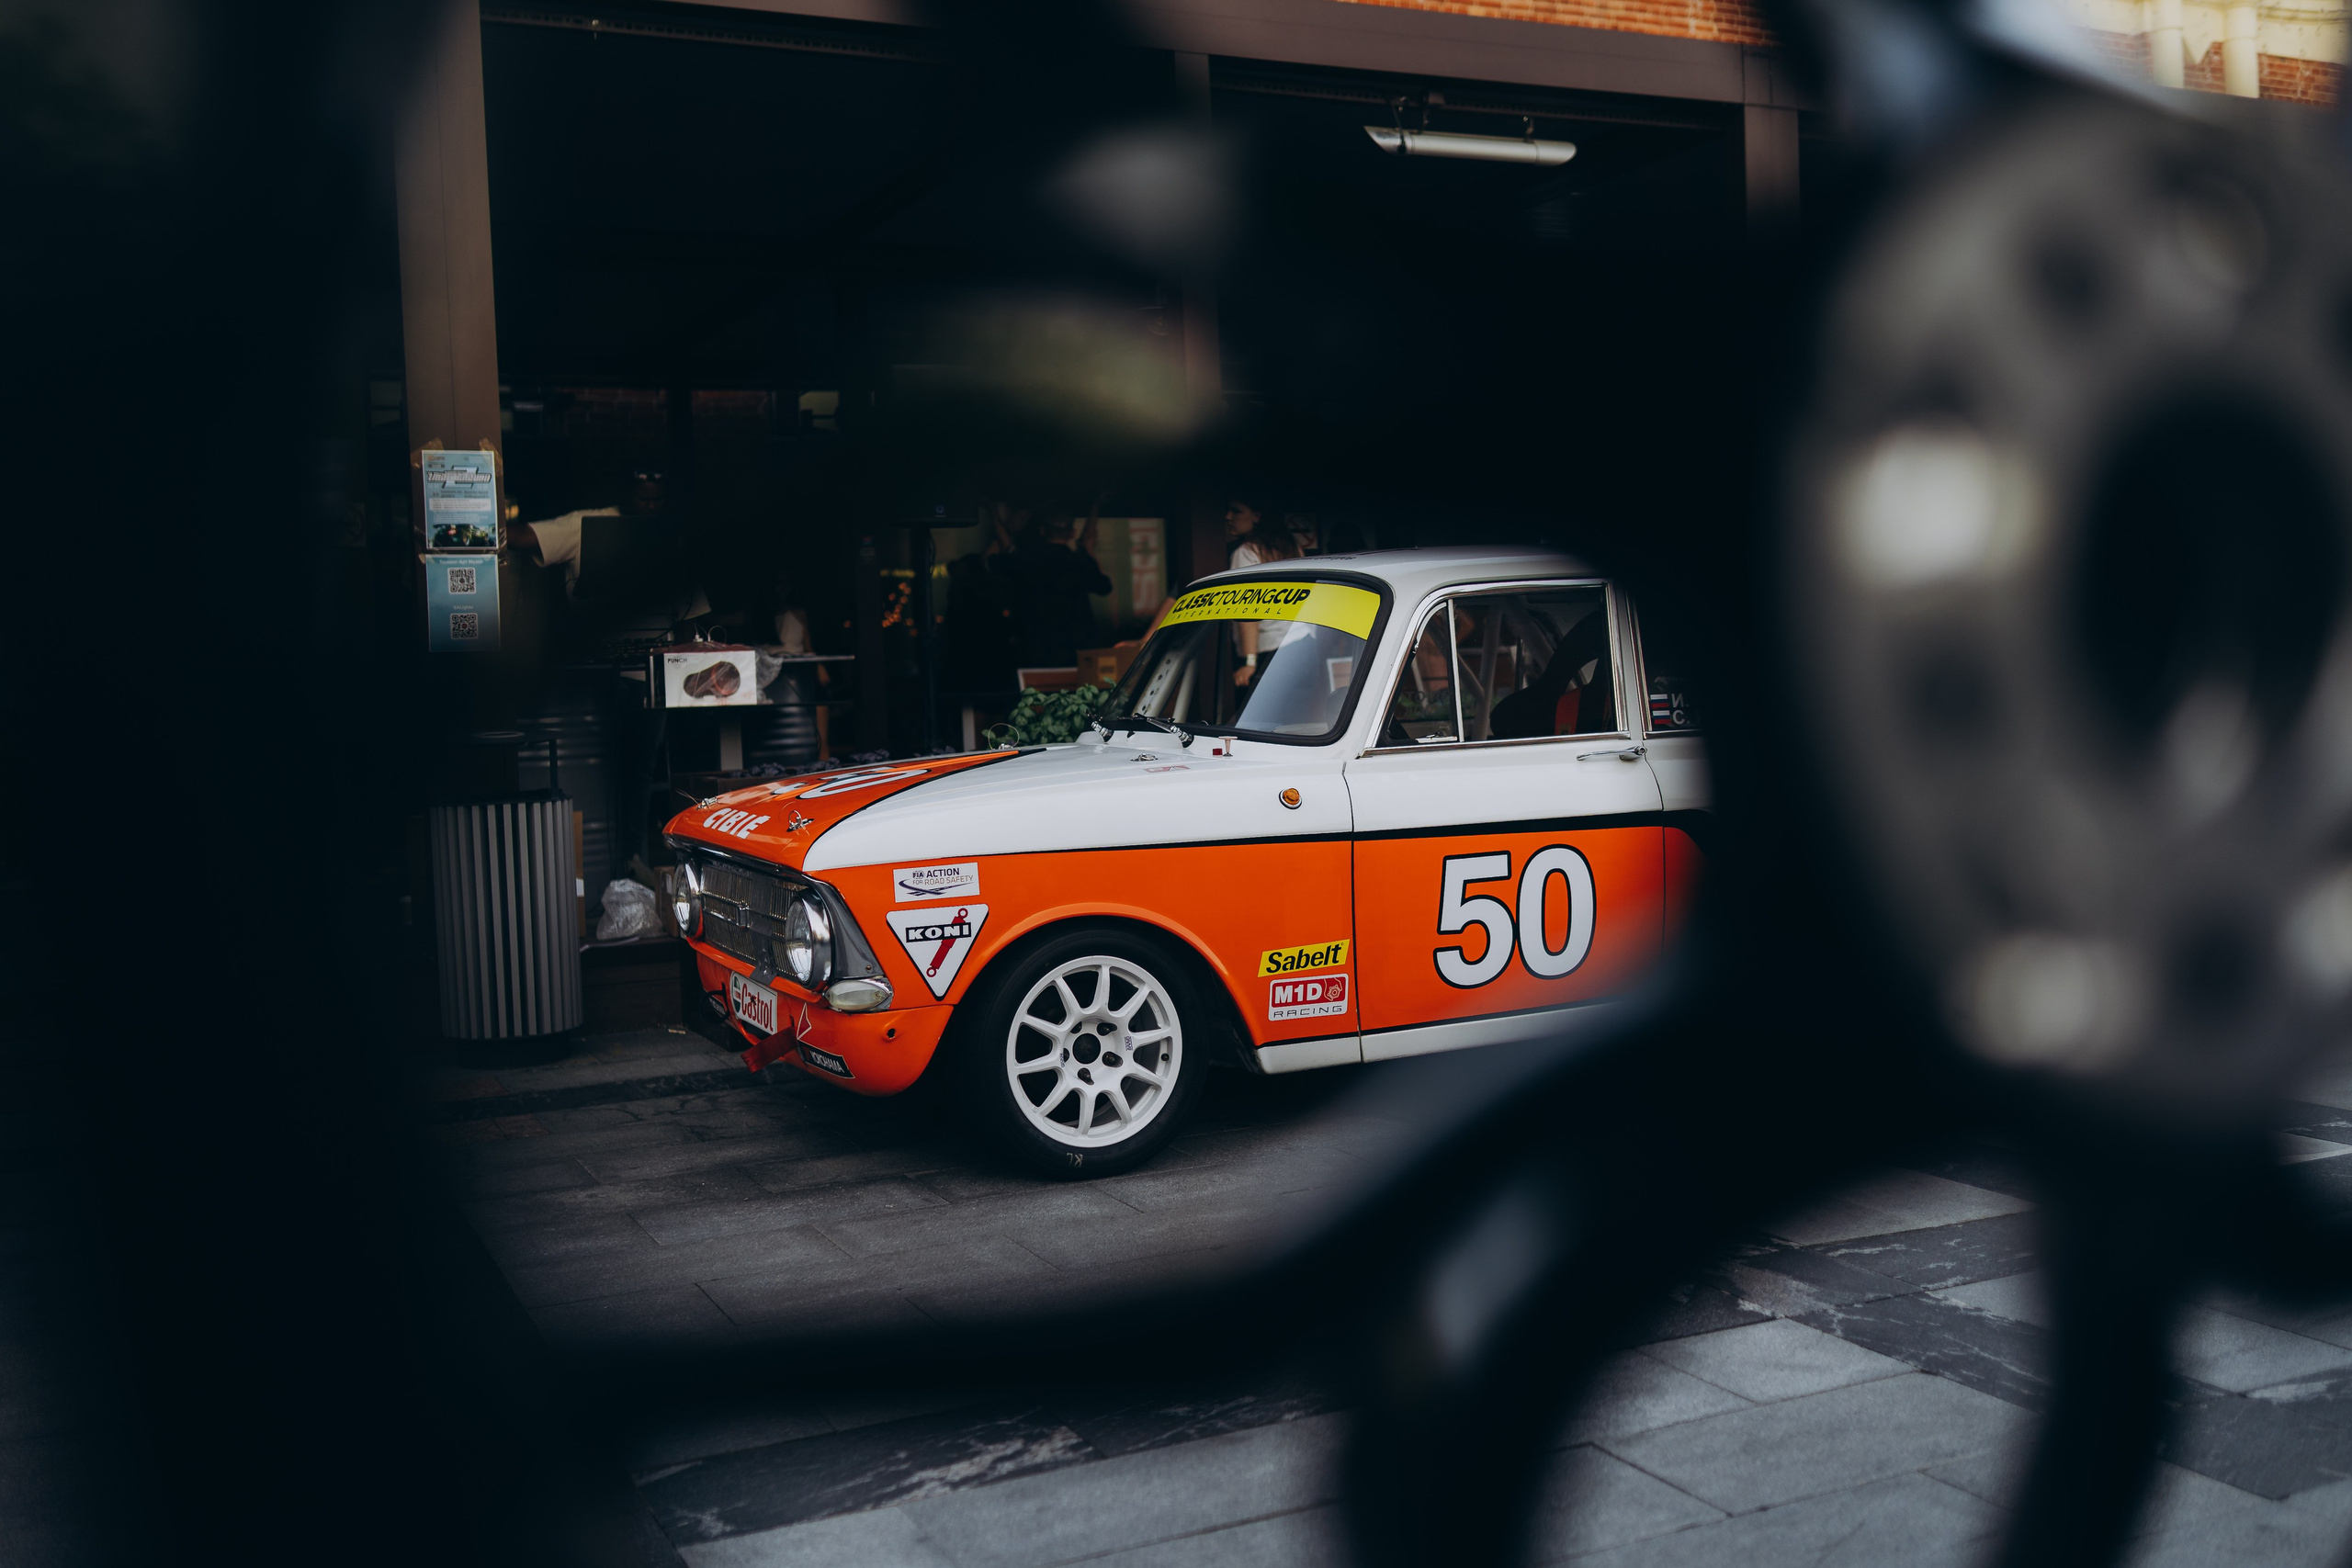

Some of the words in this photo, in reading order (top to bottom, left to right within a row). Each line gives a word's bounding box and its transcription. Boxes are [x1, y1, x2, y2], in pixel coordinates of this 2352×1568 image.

[1170, 607, 1283, 620] INTERNATIONAL
[924, 877, 944, 886] ROAD
[946, 875, 974, 884] SAFETY
[926, 868, 960, 878] ACTION
[1433, 843, 1597, 989] 50
[909, 925, 969, 941] KONI
[1266, 943, 1342, 974] Sabelt
[1274, 983, 1323, 1005] M1D
[741, 982, 774, 1032] Castrol
[1273, 1005, 1342, 1019] RACING
[810, 1051, 845, 1074] YOKOHAMA
